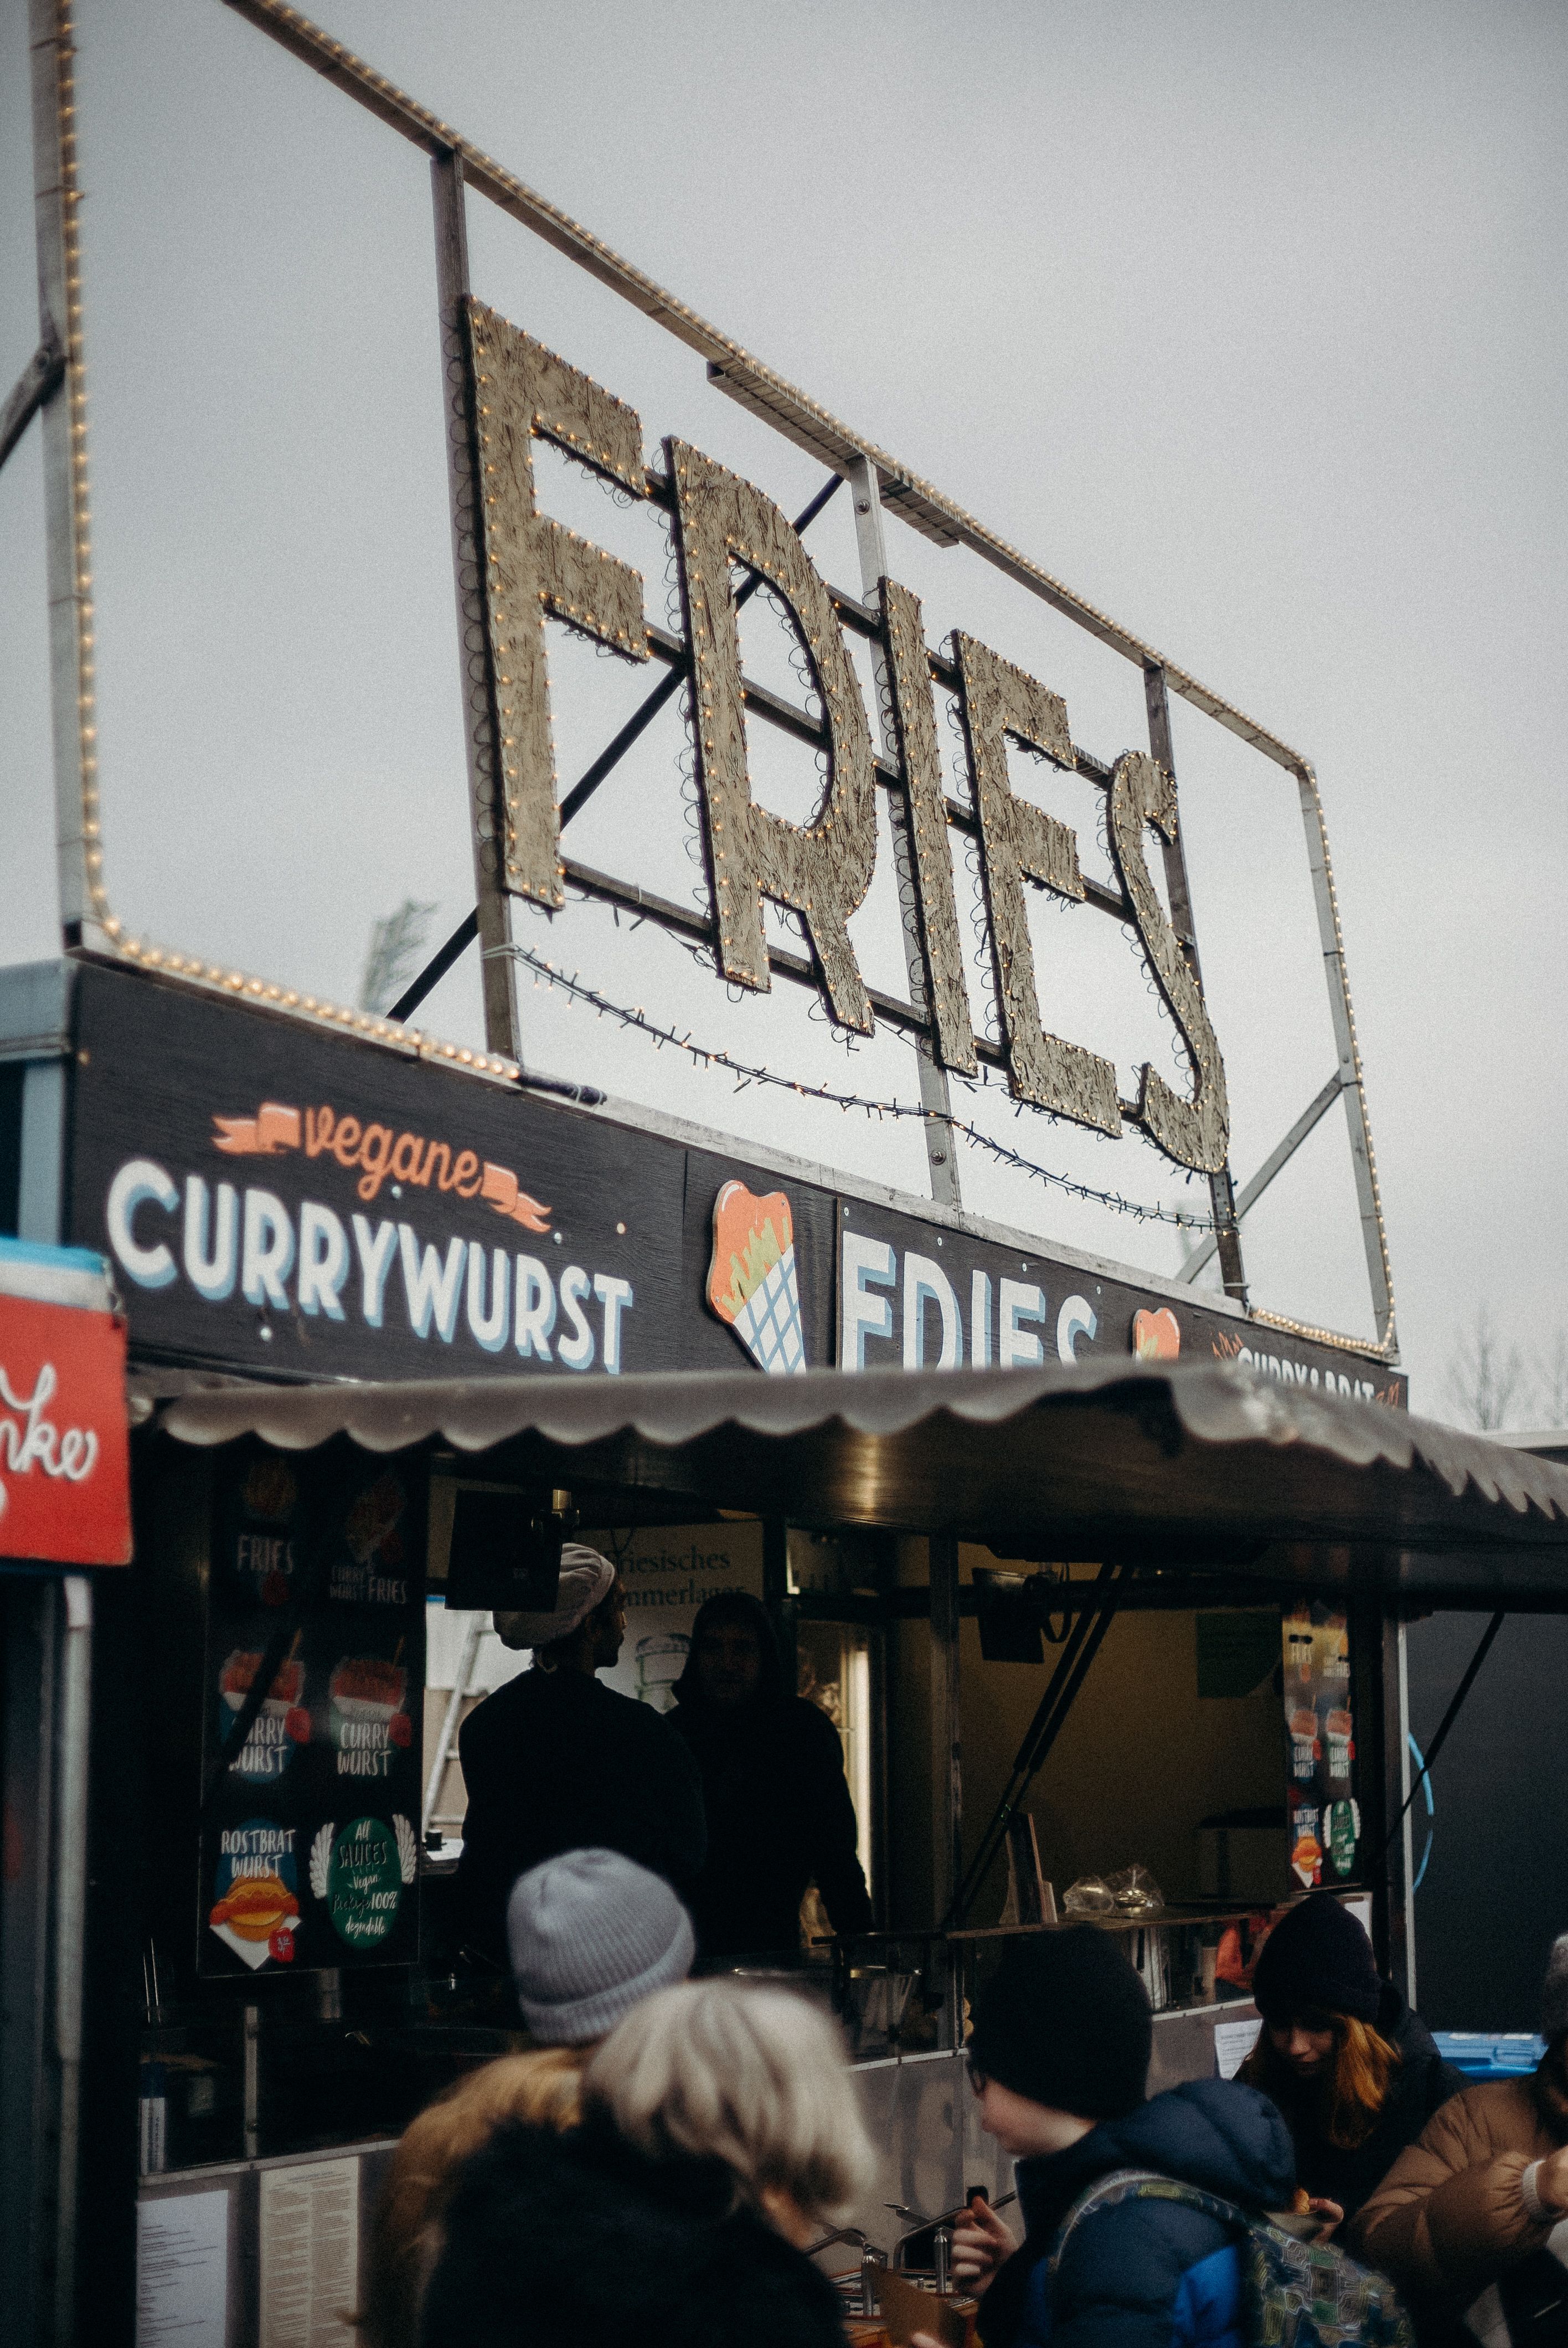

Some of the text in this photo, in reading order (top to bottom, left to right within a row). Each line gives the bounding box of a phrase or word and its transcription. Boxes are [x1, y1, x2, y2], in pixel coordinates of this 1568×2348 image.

[465, 295, 1230, 1174] FRIES
[304, 1106, 483, 1201] vegane
[107, 1157, 632, 1375] CURRYWURST
[0, 1363, 98, 1481] nke
[237, 1534, 293, 1574] FRIES
[340, 1722, 390, 1749] CURRY
[337, 1749, 391, 1777] WURST
[221, 1829, 296, 1855] ROSTBRAT
[339, 1841, 388, 1869] SAUCES
[231, 1854, 283, 1879] WURST
[371, 1890, 399, 1910] 100%
